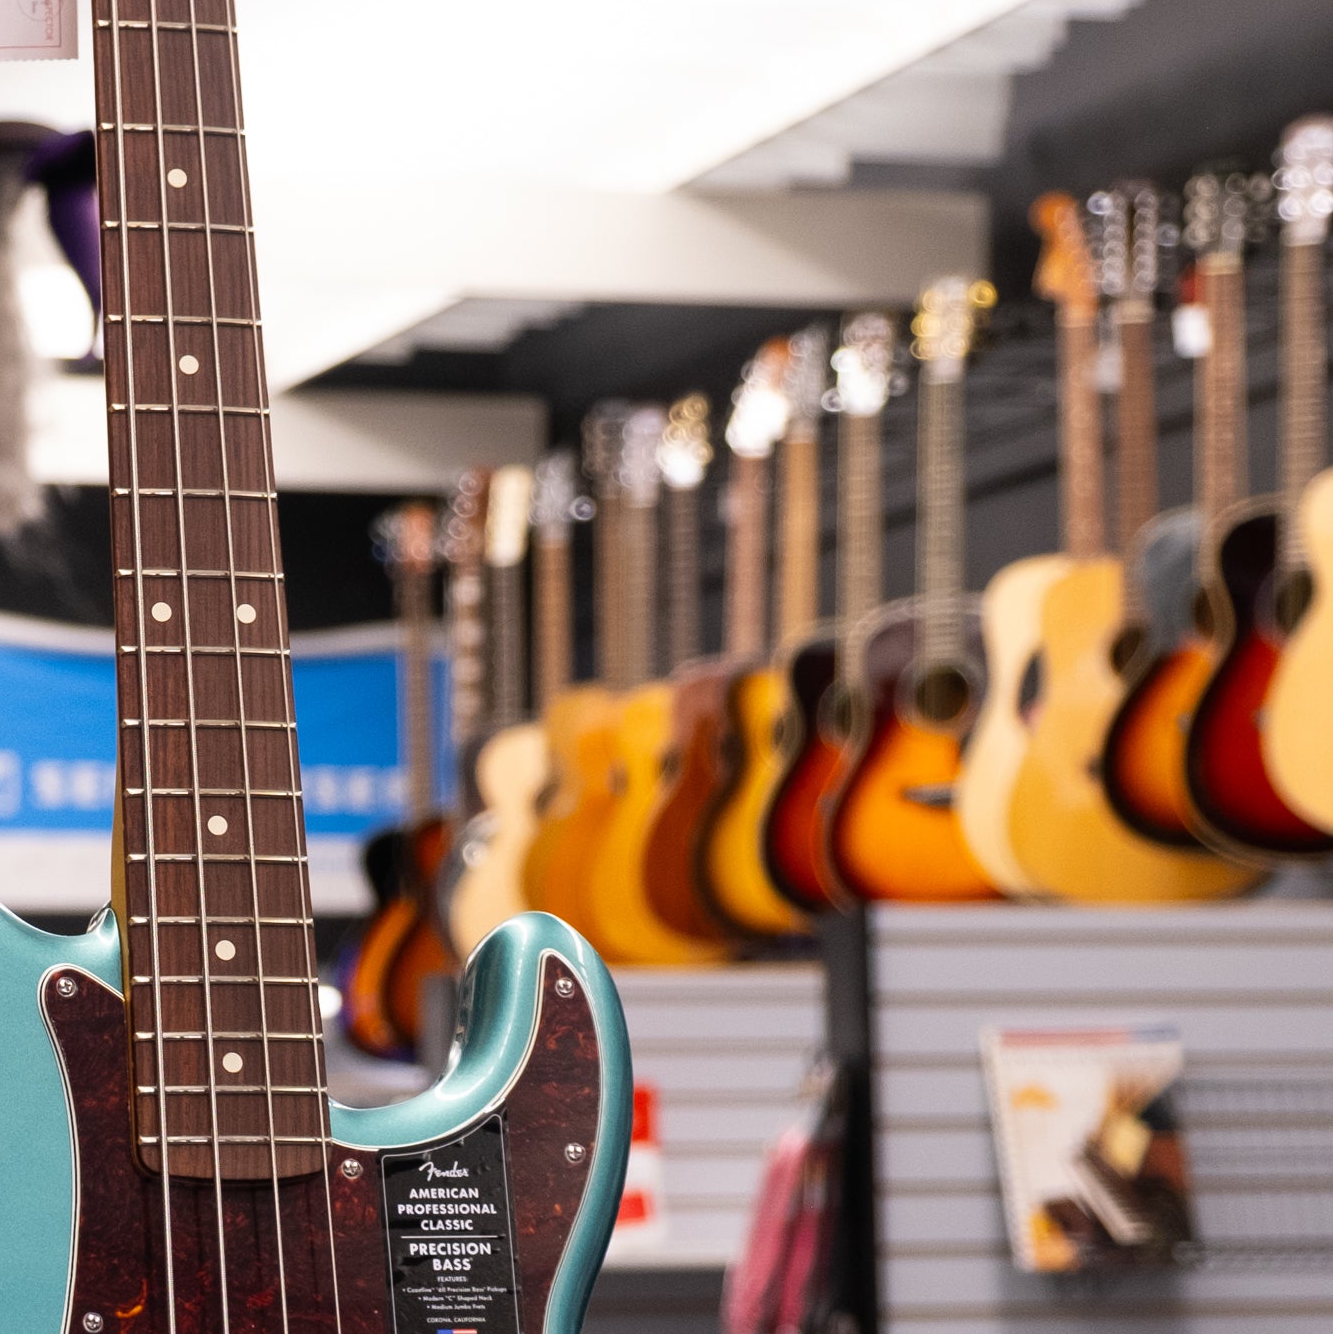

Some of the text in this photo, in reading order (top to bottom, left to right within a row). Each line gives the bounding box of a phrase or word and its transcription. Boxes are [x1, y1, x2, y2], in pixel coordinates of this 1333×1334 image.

[418, 1161, 470, 1181] Fender
[409, 1188, 479, 1199] AMERICAN
[397, 1203, 498, 1215] PROFESSIONAL
[420, 1219, 474, 1231] CLASSIC
[409, 1242, 492, 1256] PRECISION
[432, 1258, 472, 1271] BASS
